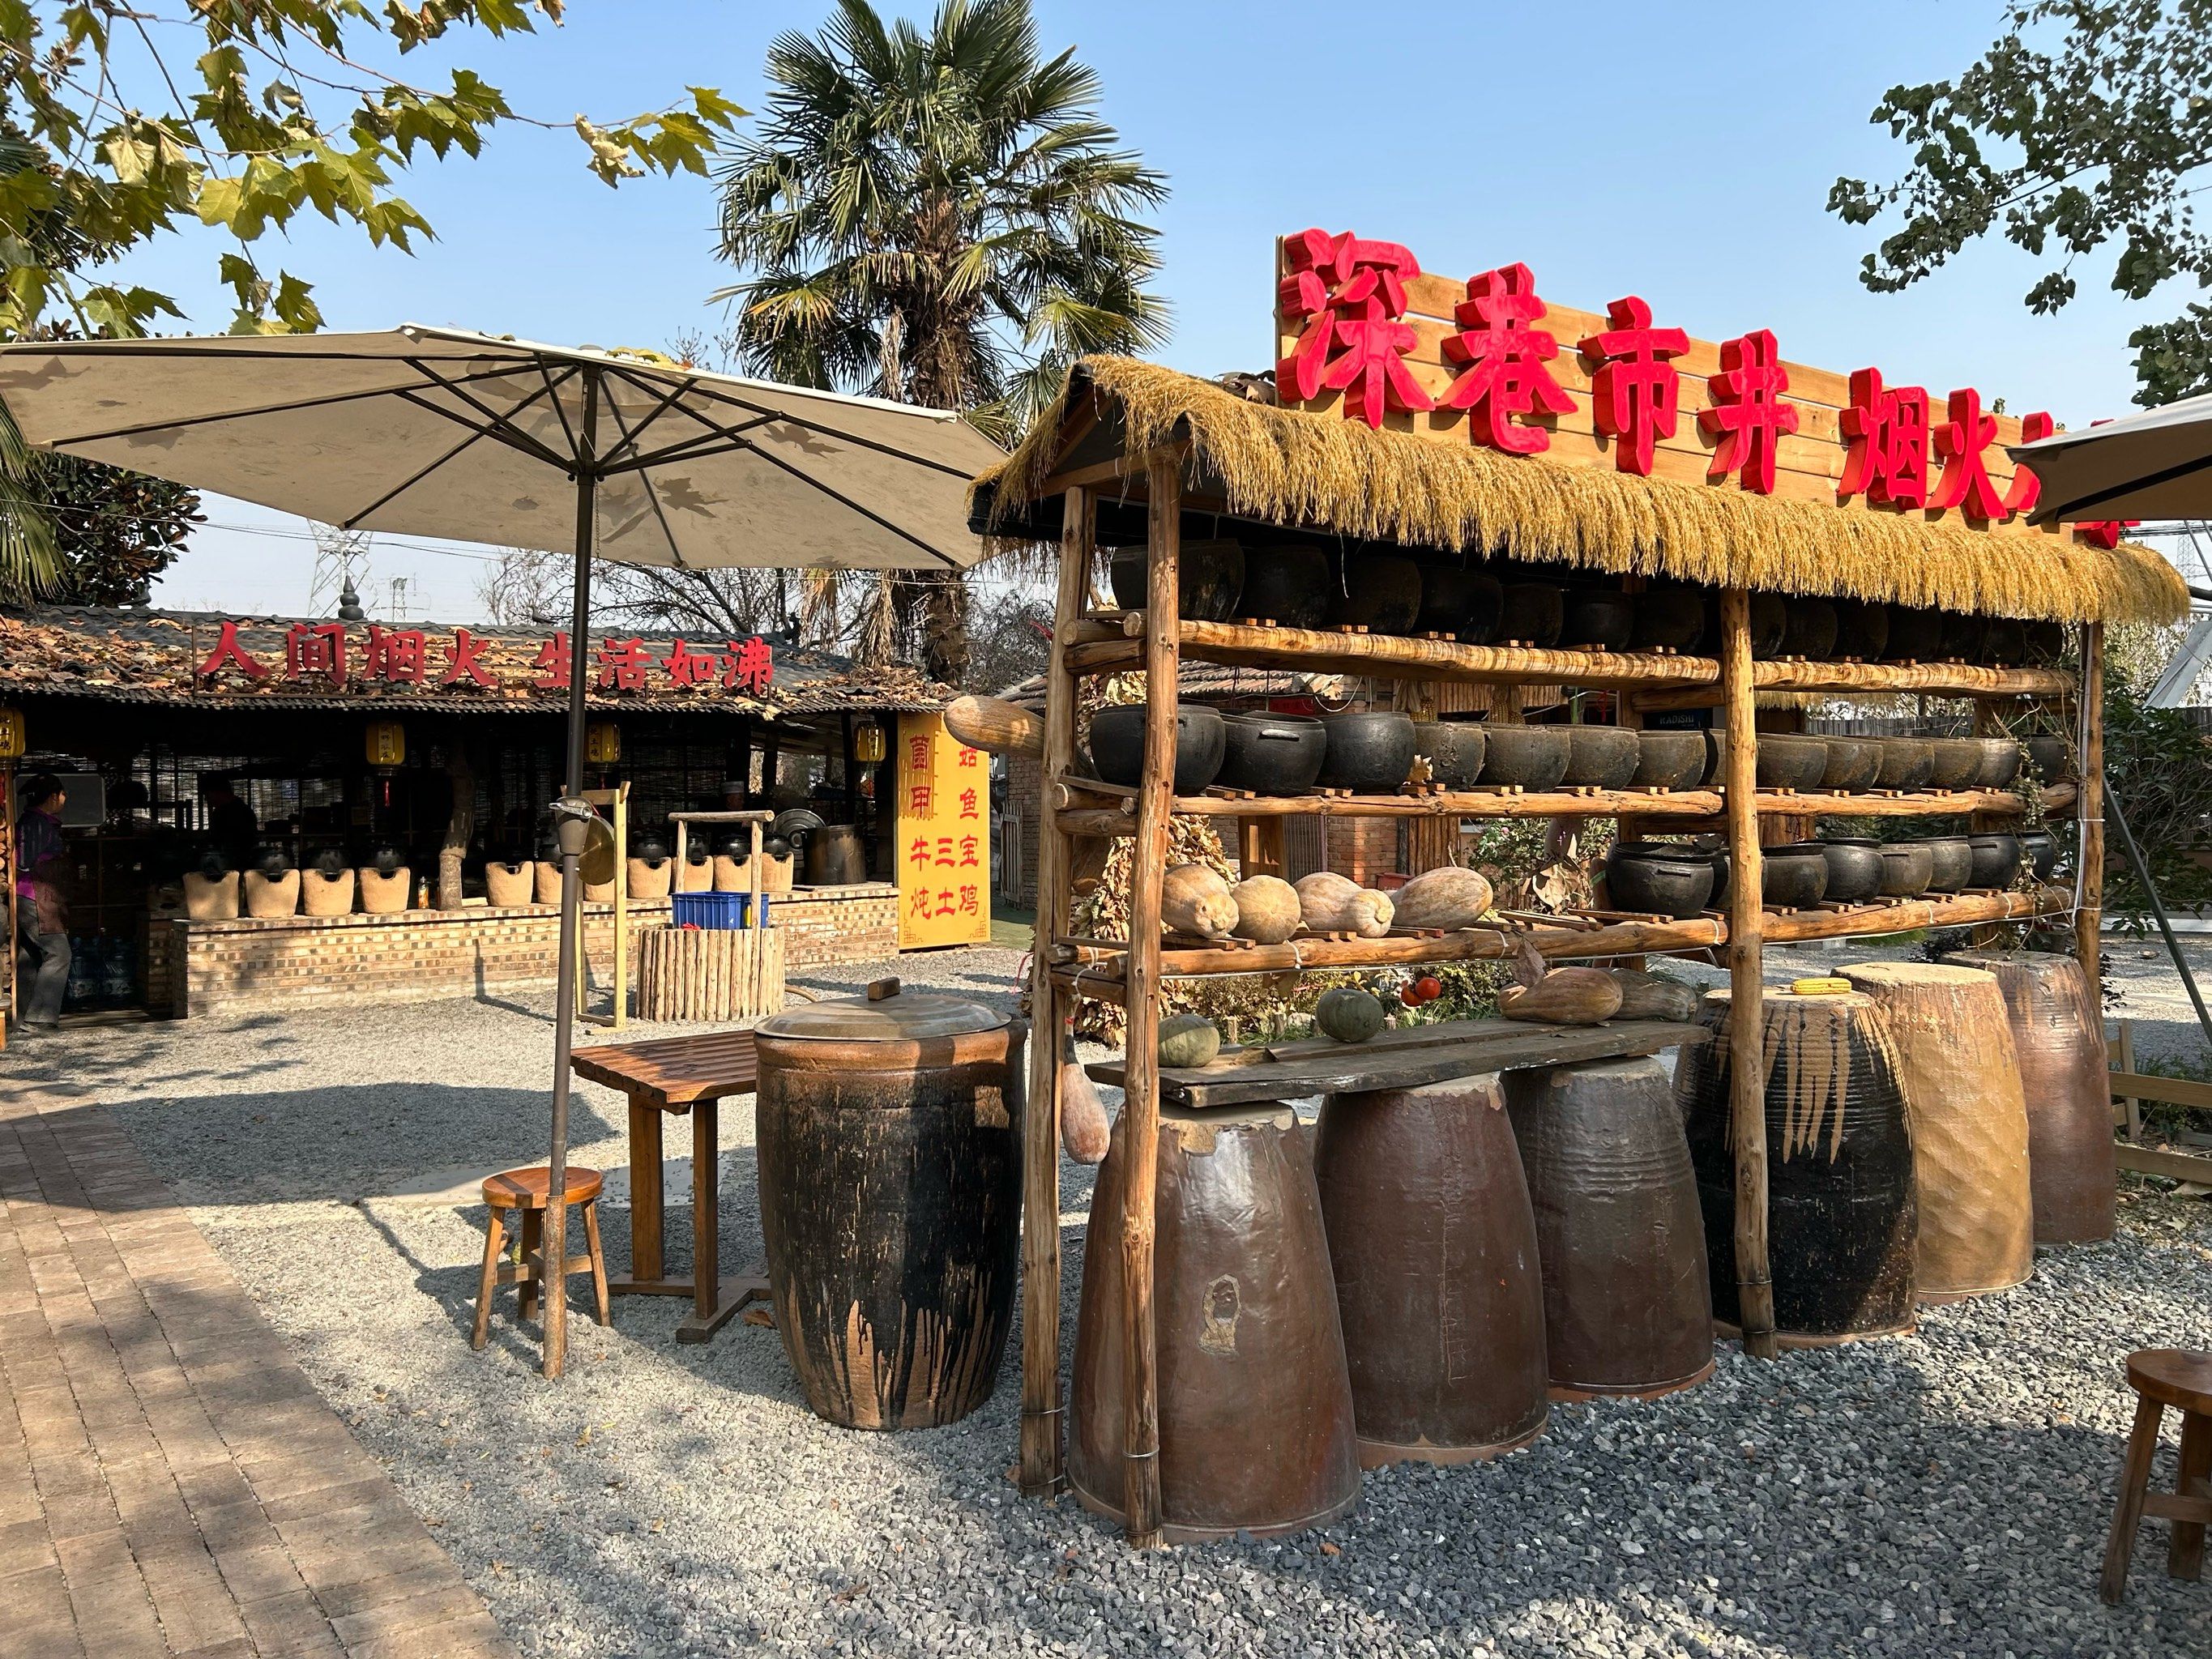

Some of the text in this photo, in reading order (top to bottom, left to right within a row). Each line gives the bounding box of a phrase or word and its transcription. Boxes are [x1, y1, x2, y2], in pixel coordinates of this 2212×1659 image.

[196, 621, 501, 687] 人间烟火
[910, 834, 980, 872] 牛三宝
[910, 884, 980, 920] 炖土鸡
